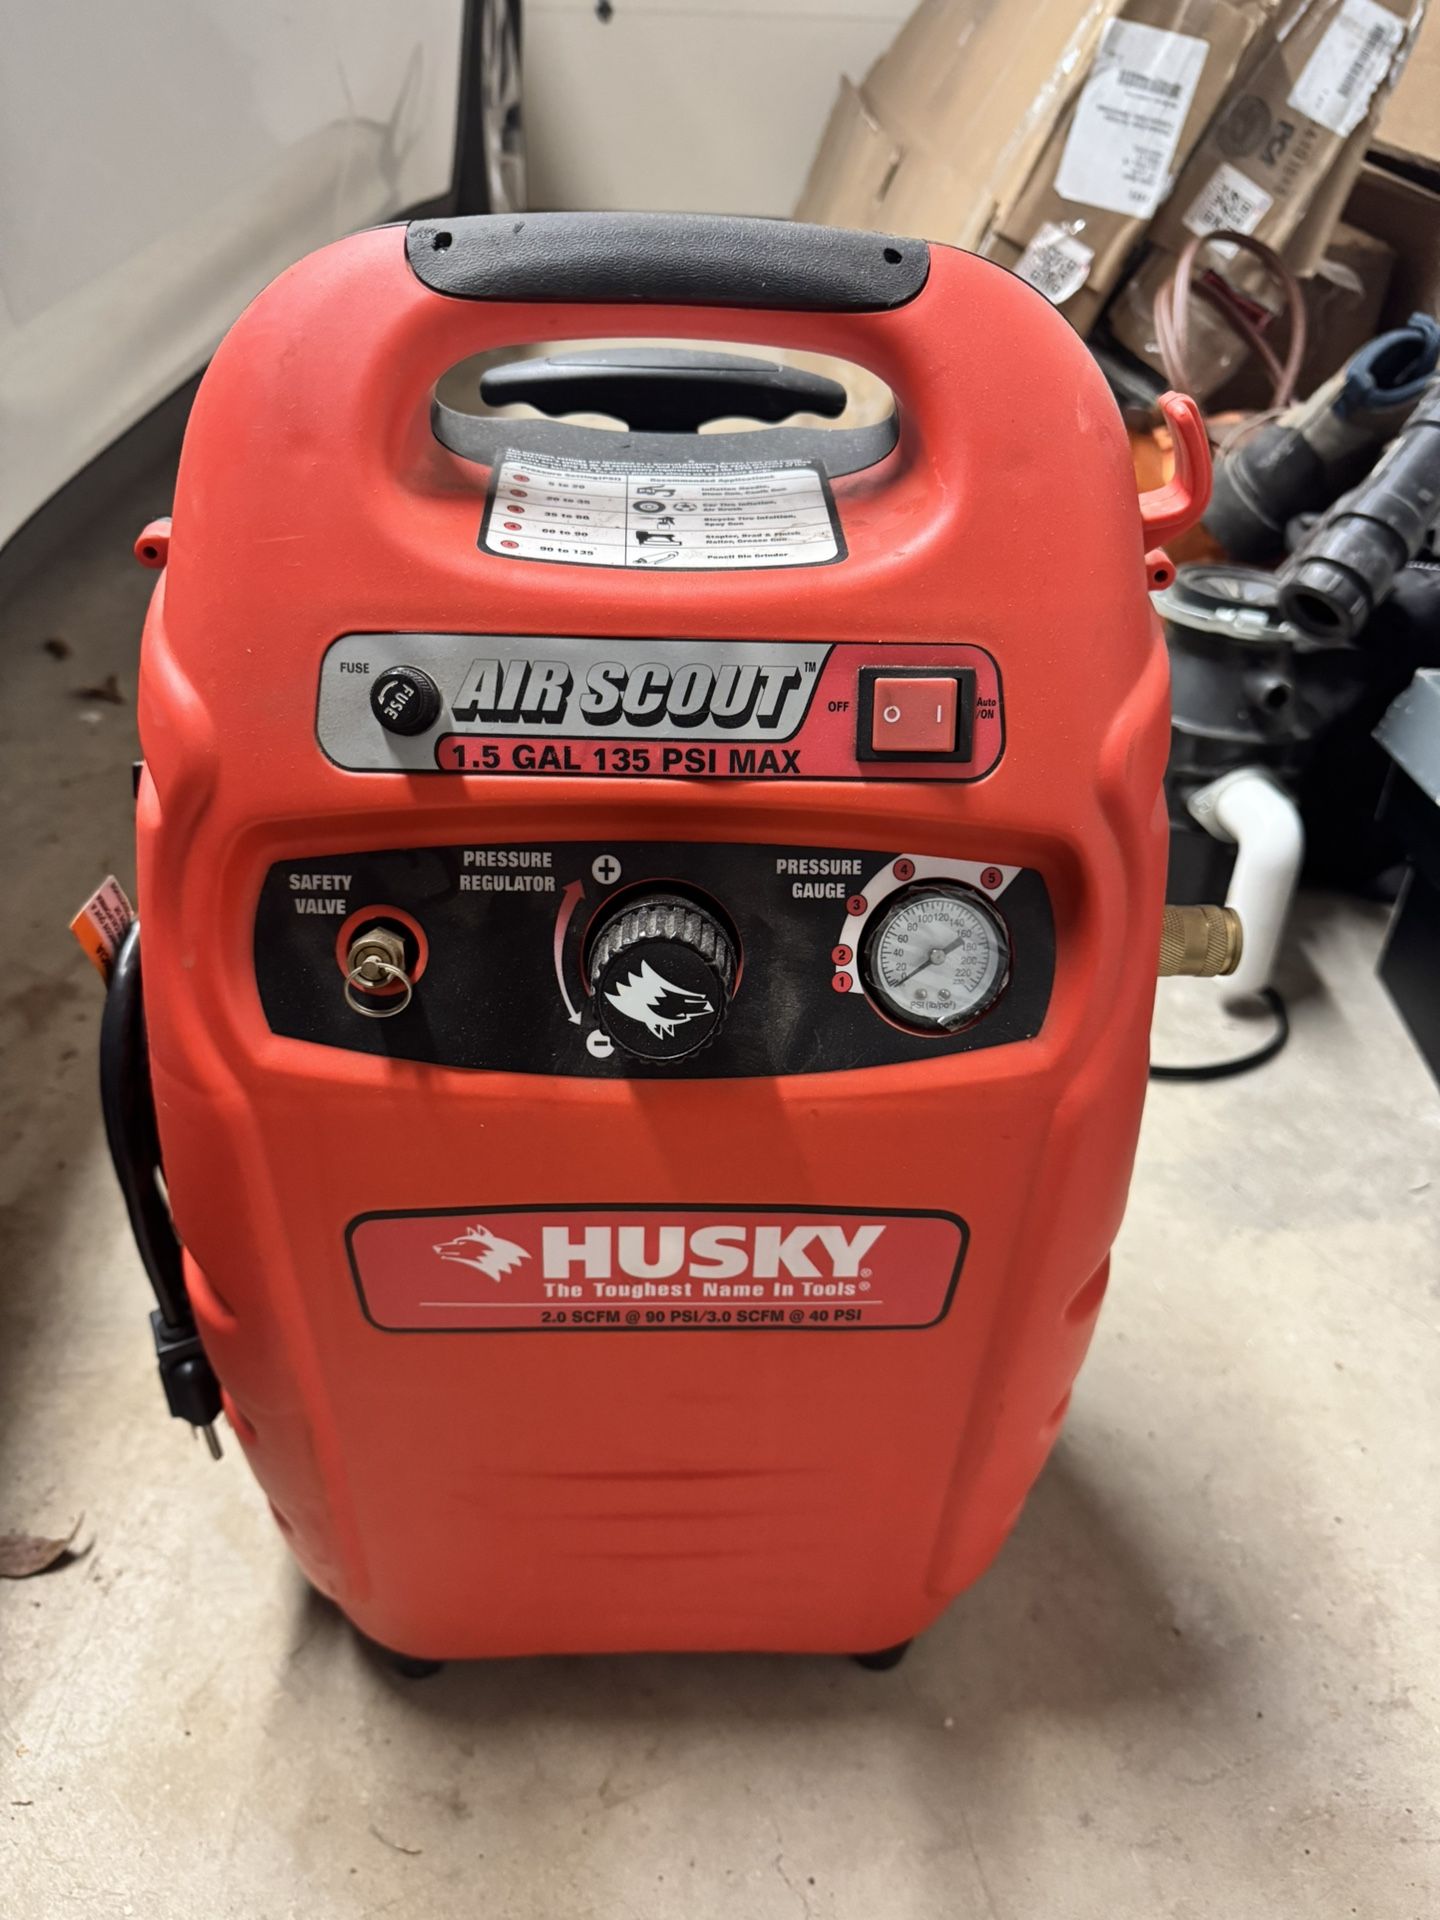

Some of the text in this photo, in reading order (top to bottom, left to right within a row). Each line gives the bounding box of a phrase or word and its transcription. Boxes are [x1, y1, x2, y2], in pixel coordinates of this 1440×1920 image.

[340, 662, 370, 674] FUSE
[452, 659, 574, 724] AIR
[579, 661, 802, 729] SCOUT
[384, 684, 414, 720] FUSE
[828, 701, 849, 712] OFF
[976, 697, 997, 707] Auto
[976, 708, 994, 719] /ON
[452, 744, 801, 774] 1.5 GAL 135 PSI MAX
[464, 852, 552, 868] PRESSURE
[776, 858, 862, 876] PRESSURE
[901, 864, 908, 875] 4
[289, 874, 352, 891] SAFETY
[988, 873, 995, 883] 5
[460, 875, 556, 892] REGULATOR
[792, 882, 846, 900] GAUGE
[294, 898, 346, 915] VALVE
[853, 900, 860, 910] 3
[918, 914, 932, 923] 100
[935, 913, 949, 922] 120
[950, 918, 965, 927] 140
[907, 922, 918, 932] 80
[897, 934, 908, 944] 60
[838, 950, 846, 960] 2
[893, 949, 904, 957] 40
[961, 957, 977, 965] 200
[896, 963, 907, 971] 20
[955, 968, 971, 977] 220
[839, 977, 844, 987] 1
[910, 1002, 925, 1010] PSI
[544, 1283, 583, 1298] The
[593, 1282, 692, 1299] Toughest
[702, 1282, 764, 1297] Name
[773, 1282, 794, 1297] In
[541, 1311, 566, 1323] 2.0
[572, 1310, 620, 1323] SCFM
[626, 1310, 640, 1324] @
[646, 1311, 665, 1323] 90
[737, 1310, 784, 1322] SCFM
[790, 1309, 804, 1323] @
[809, 1310, 829, 1322] 40
[833, 1309, 862, 1321] PSI
